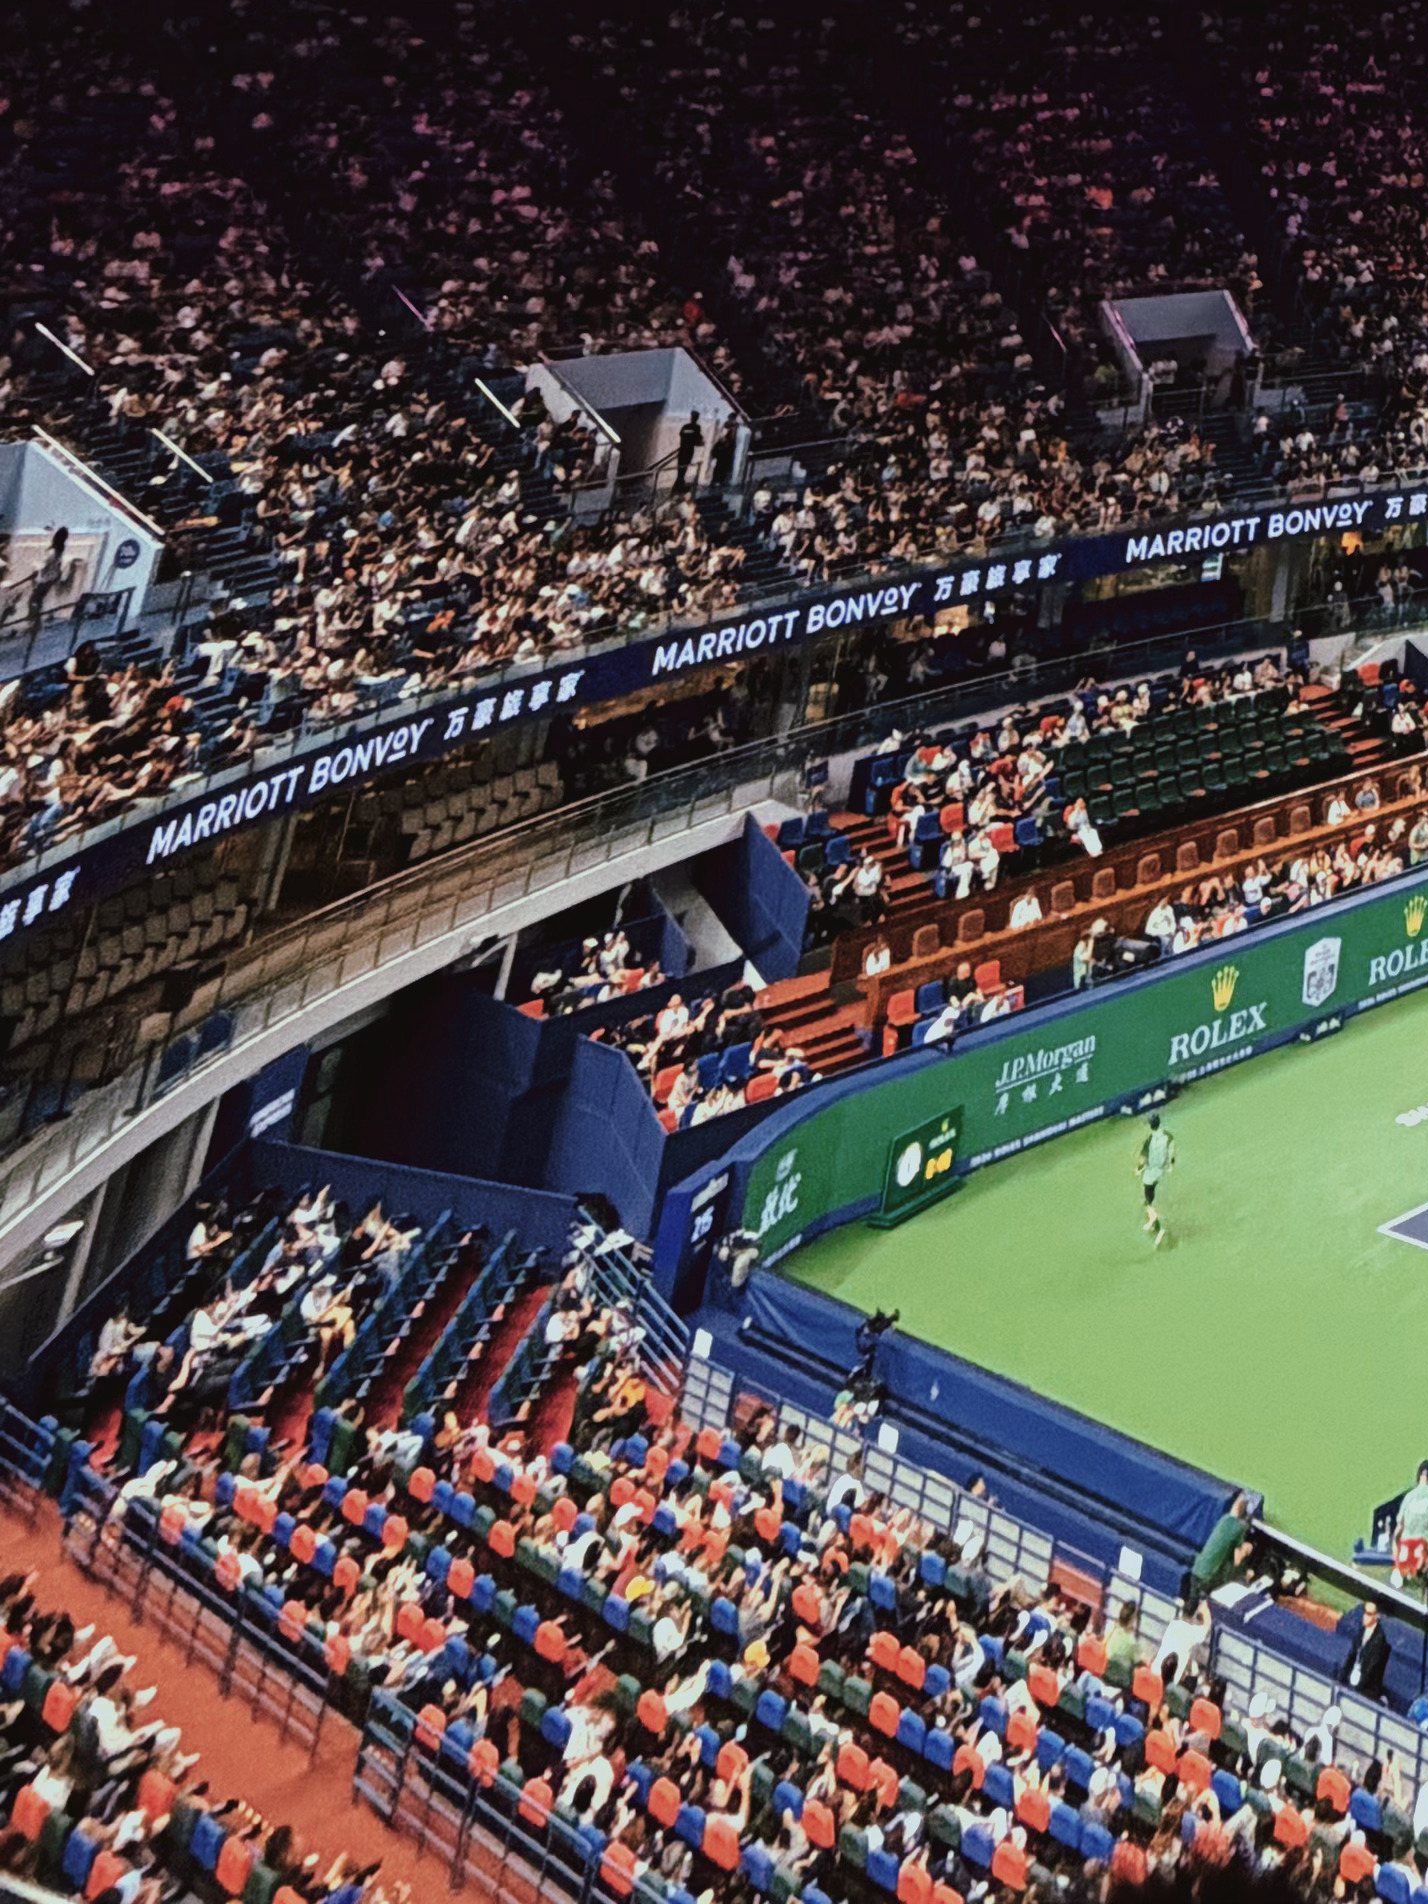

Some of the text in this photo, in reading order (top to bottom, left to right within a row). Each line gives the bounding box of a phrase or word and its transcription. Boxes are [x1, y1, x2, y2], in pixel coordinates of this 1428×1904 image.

[1125, 516, 1261, 563] MARRIOTT
[1267, 500, 1374, 539] BONVOY
[651, 610, 800, 676] MARRIOTT
[803, 577, 924, 634] BONVOY
[146, 762, 305, 865] MARRIOTT
[307, 718, 435, 793] BONVOY
[1167, 1001, 1269, 1066] ROLEX
